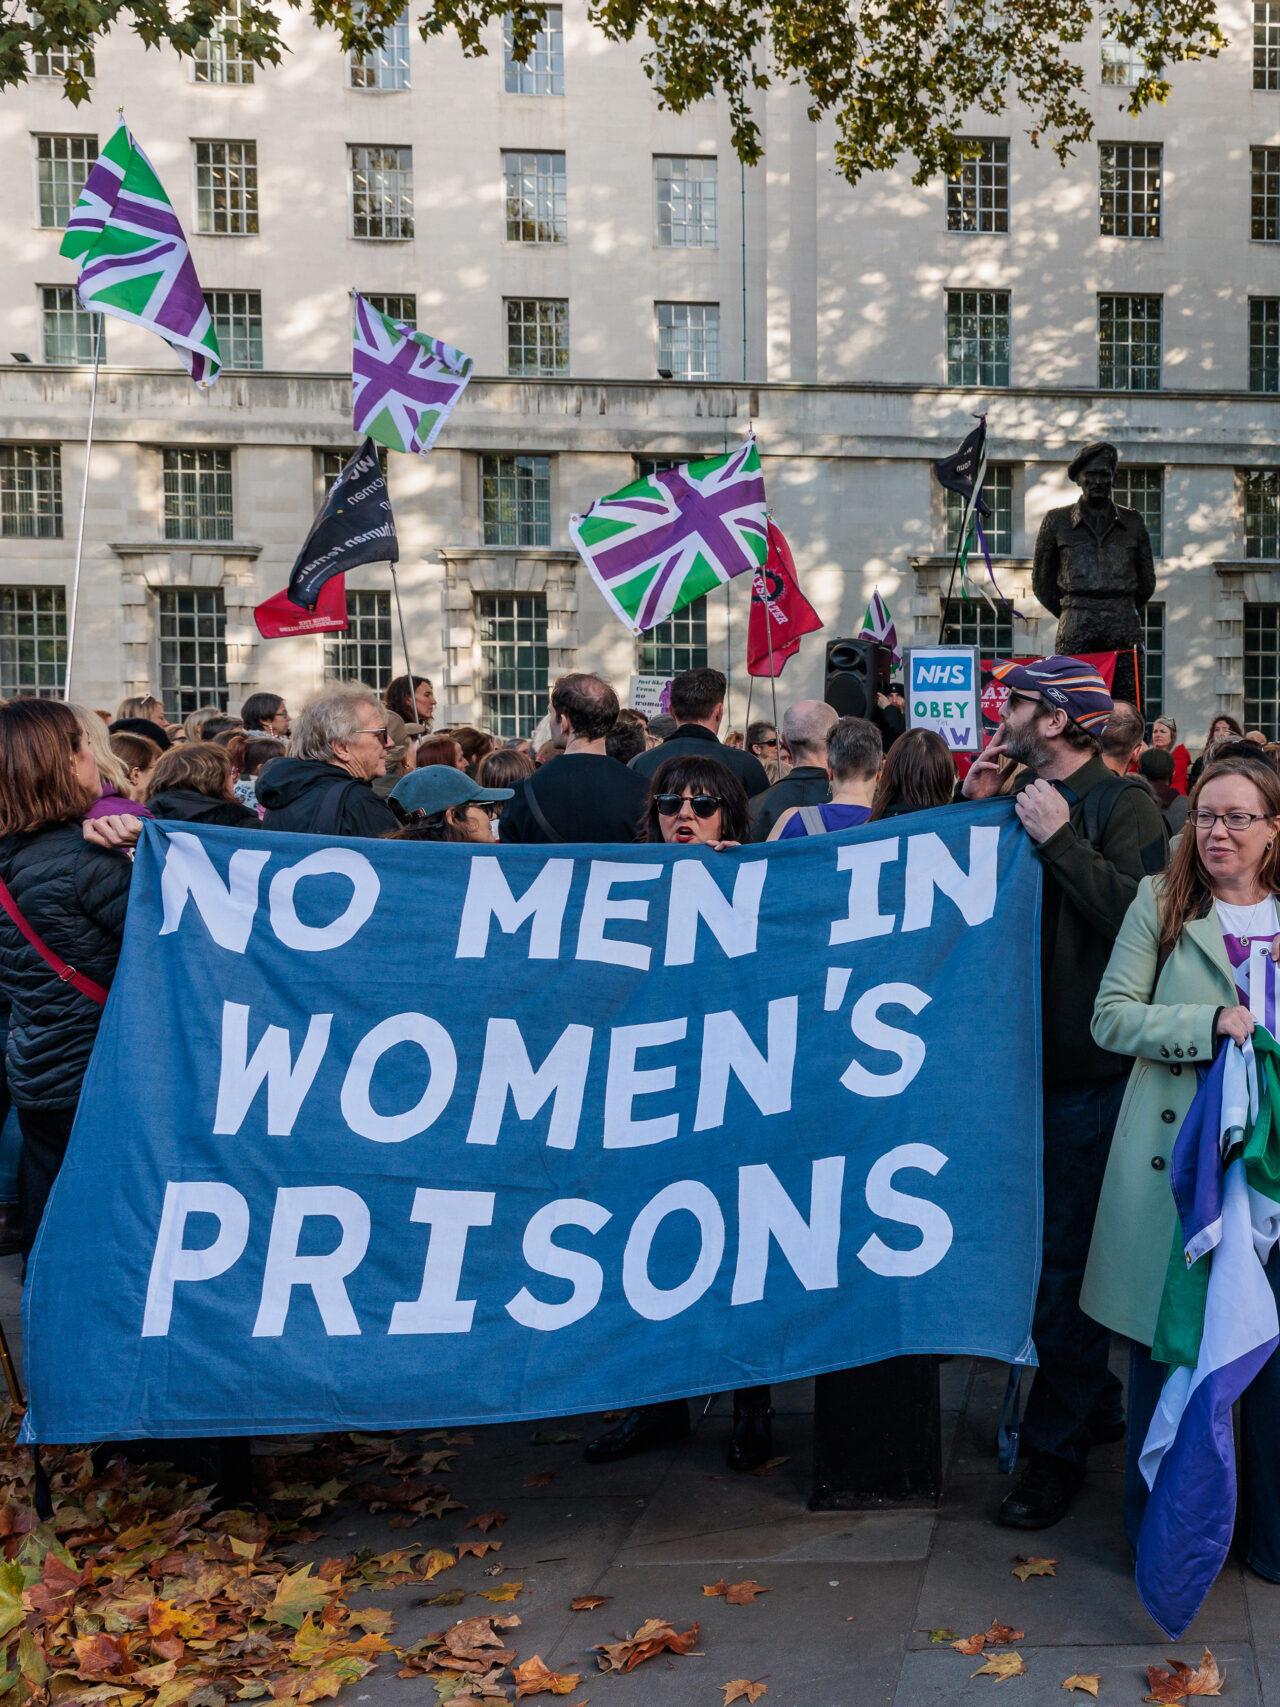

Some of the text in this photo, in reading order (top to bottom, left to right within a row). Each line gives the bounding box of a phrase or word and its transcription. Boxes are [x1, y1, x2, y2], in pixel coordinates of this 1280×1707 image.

[914, 701, 969, 719] OBEY
[917, 665, 965, 685] NHS
[939, 727, 970, 746] AW
[159, 826, 1000, 971] NO MEN IN
[213, 967, 932, 1150] WOMEN'S
[142, 1143, 954, 1338] PRISONS
